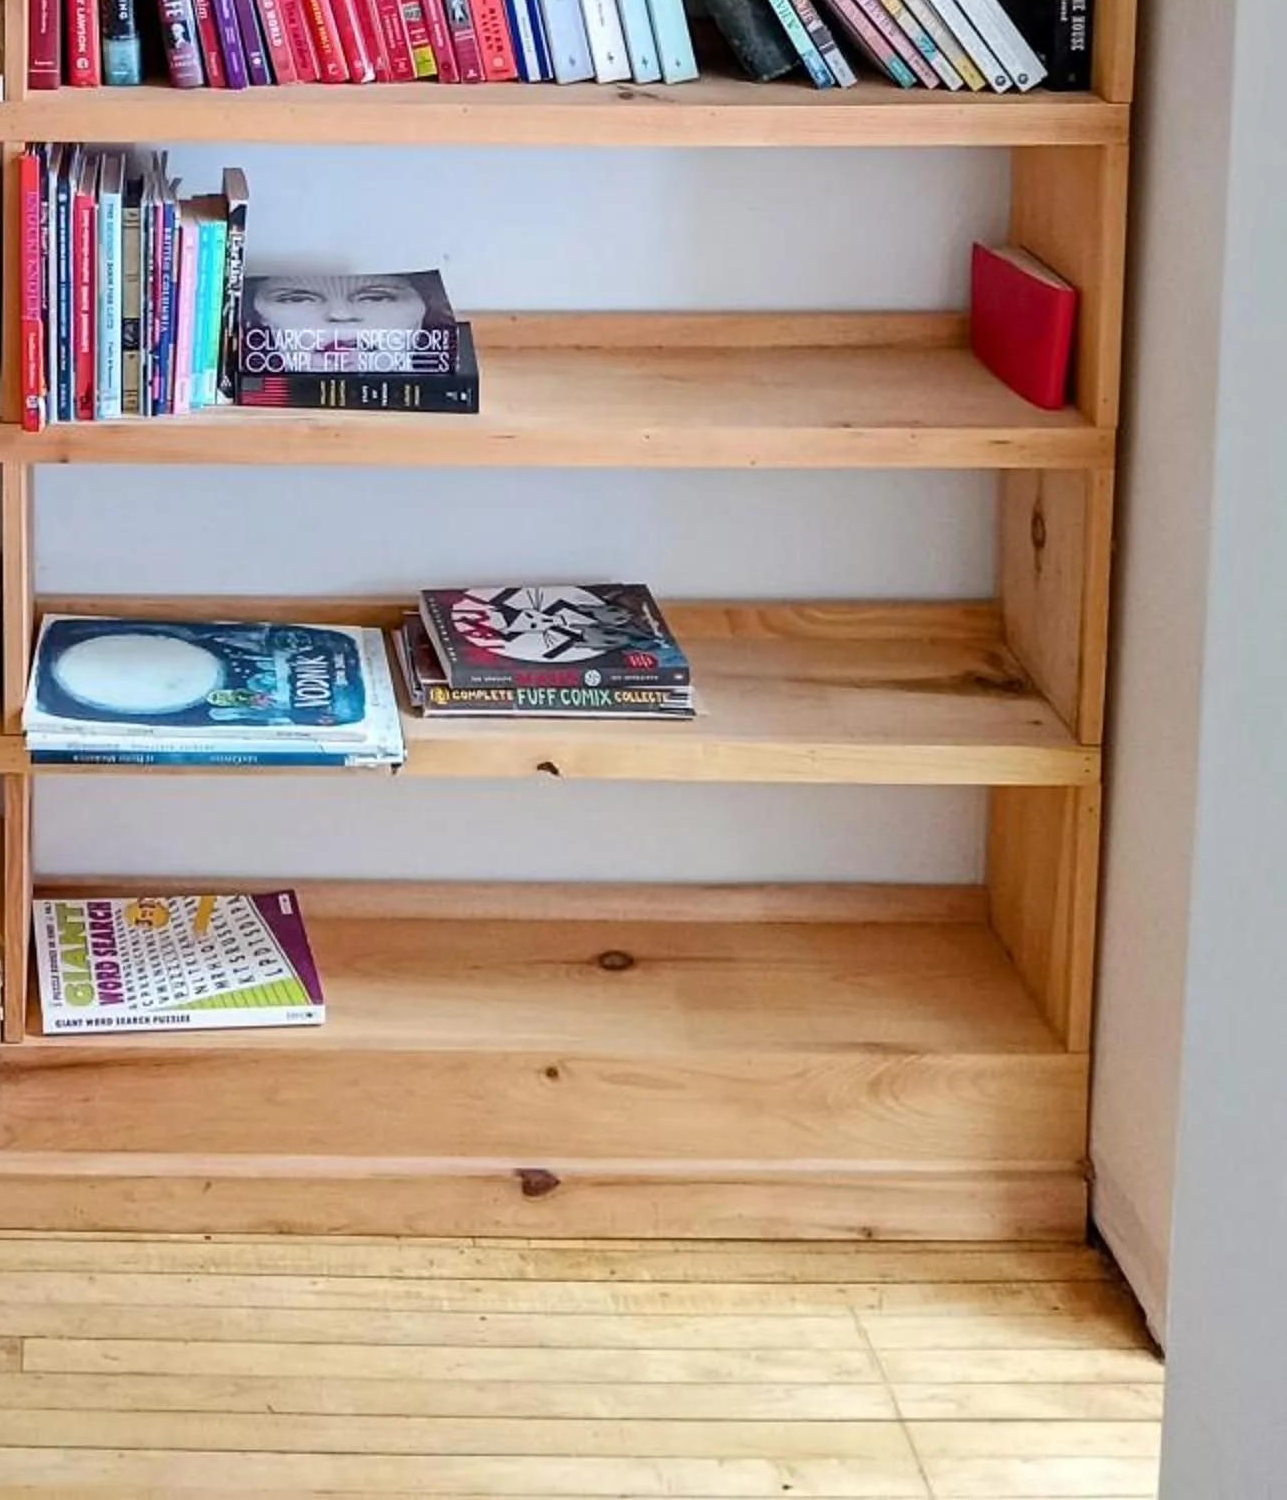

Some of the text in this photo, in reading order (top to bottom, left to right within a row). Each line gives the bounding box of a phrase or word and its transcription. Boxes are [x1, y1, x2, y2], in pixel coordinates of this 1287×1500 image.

[76, 7, 86, 52] LAWSON
[266, 12, 282, 47] WORLD
[1071, 16, 1085, 51] HOUSE
[160, 228, 172, 332] BRITISH COLUMBIA
[246, 329, 326, 351] CLARICE
[246, 352, 450, 373] COMPLETE STORIES
[452, 689, 514, 701] COMPLETE
[517, 689, 558, 705] FUFF
[561, 688, 611, 705] COMIX
[54, 902, 94, 1007] GIANT
[88, 901, 124, 1006] WORD SEARCH
[55, 1018, 83, 1028] GIANT
[86, 1017, 113, 1027] WORD
[115, 1016, 151, 1025] SEARCH
